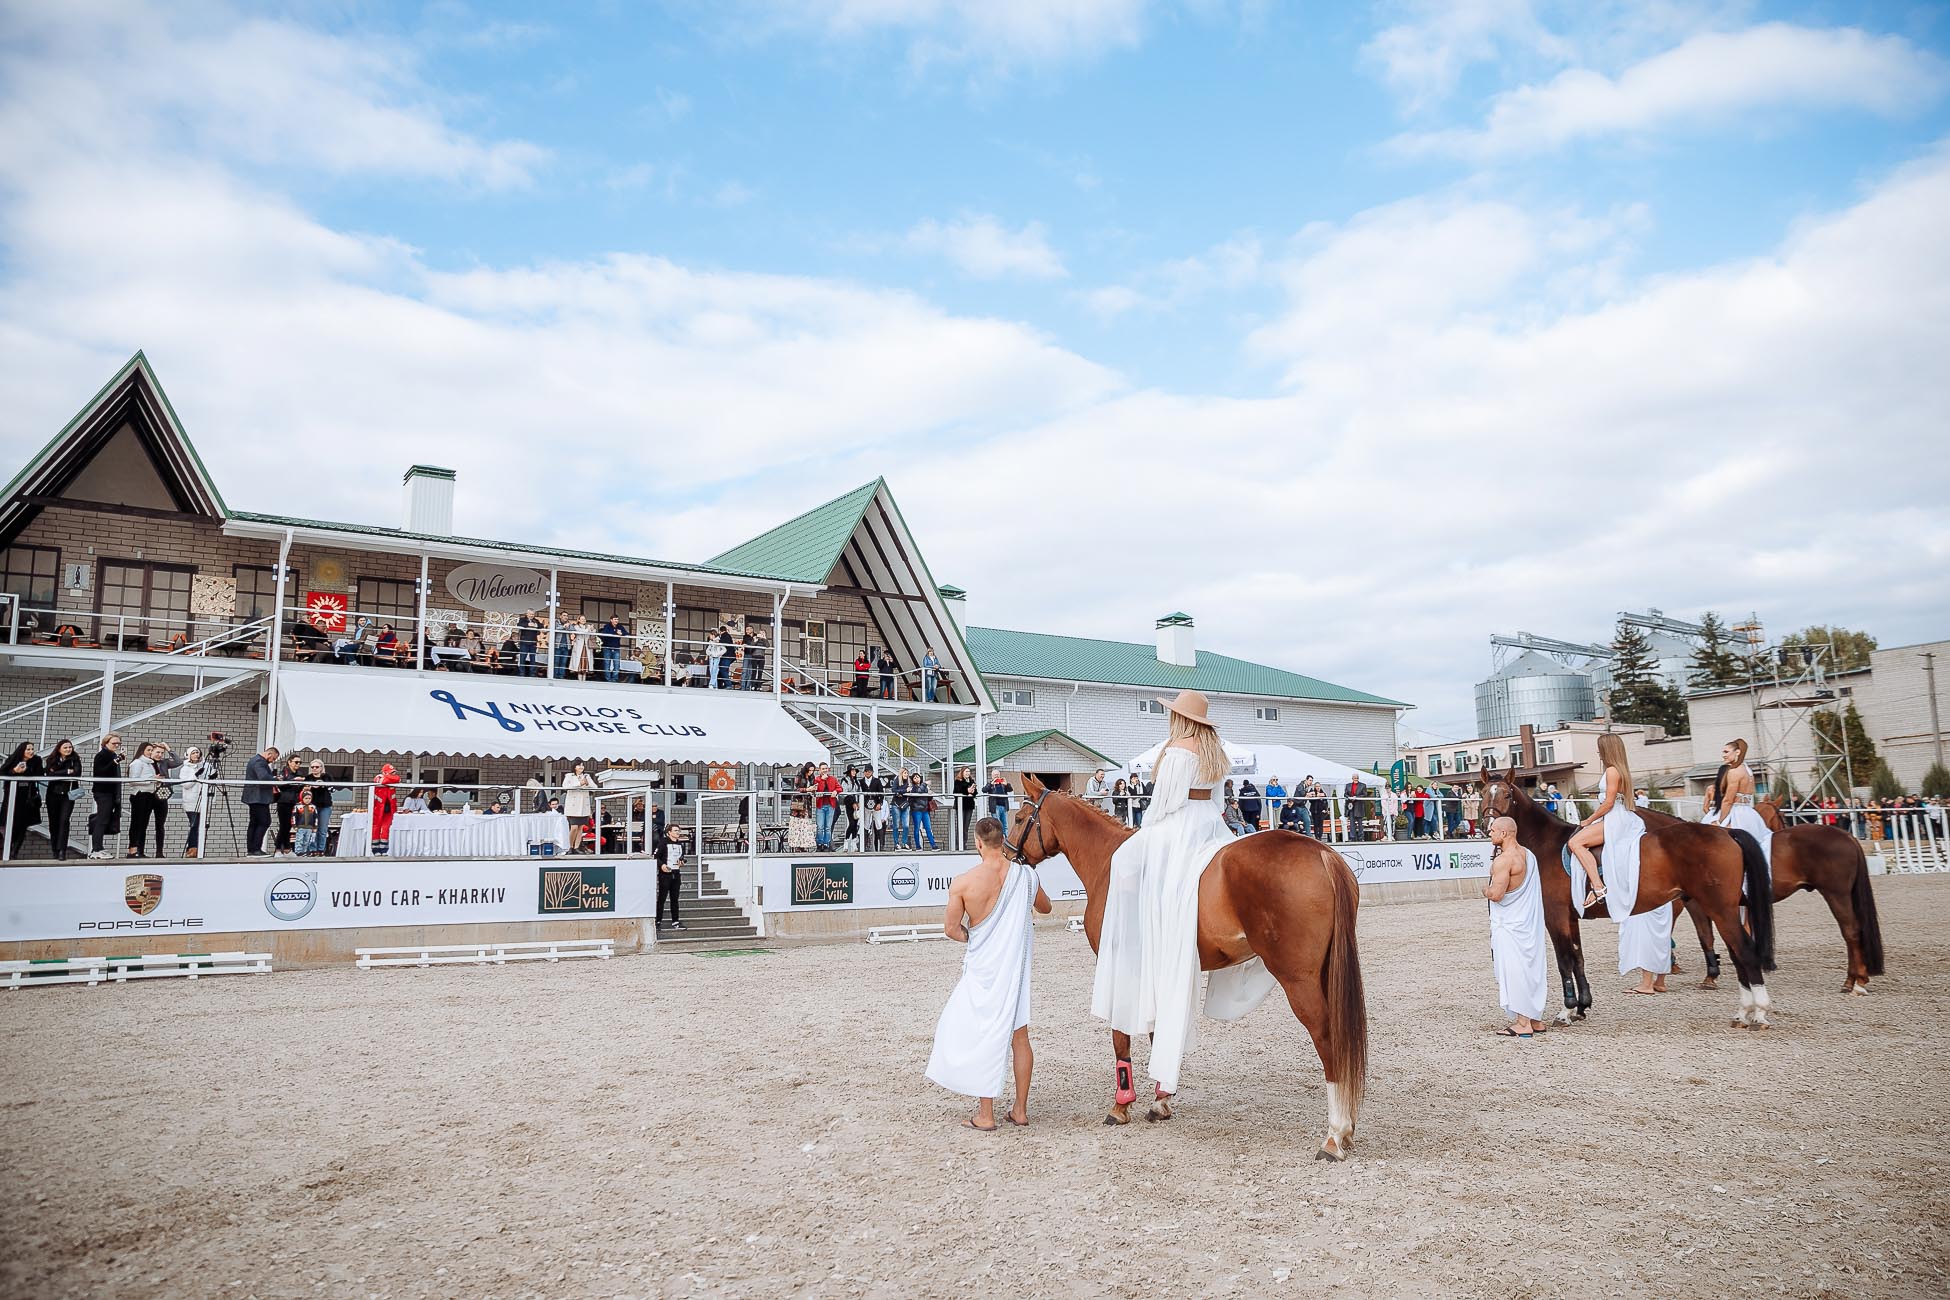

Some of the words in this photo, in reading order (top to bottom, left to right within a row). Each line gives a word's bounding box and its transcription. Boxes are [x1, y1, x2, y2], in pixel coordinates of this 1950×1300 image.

[456, 574, 541, 601] Welcome!
[508, 702, 643, 720] NIKOLO'S
[532, 719, 631, 735] HORSE
[638, 723, 707, 737] CLUB
[1365, 859, 1403, 869] авантаж
[1412, 853, 1442, 871] VISA
[582, 882, 609, 895] Park
[826, 877, 848, 888] Park
[927, 877, 953, 891] VOLV
[272, 892, 310, 901] VOLVO
[331, 890, 382, 908] VOLVO
[391, 889, 420, 906] CAR
[438, 887, 506, 905] KHARKIV
[826, 890, 848, 901] Ville
[582, 896, 609, 909] Ville
[78, 918, 204, 931] PORSCHE
